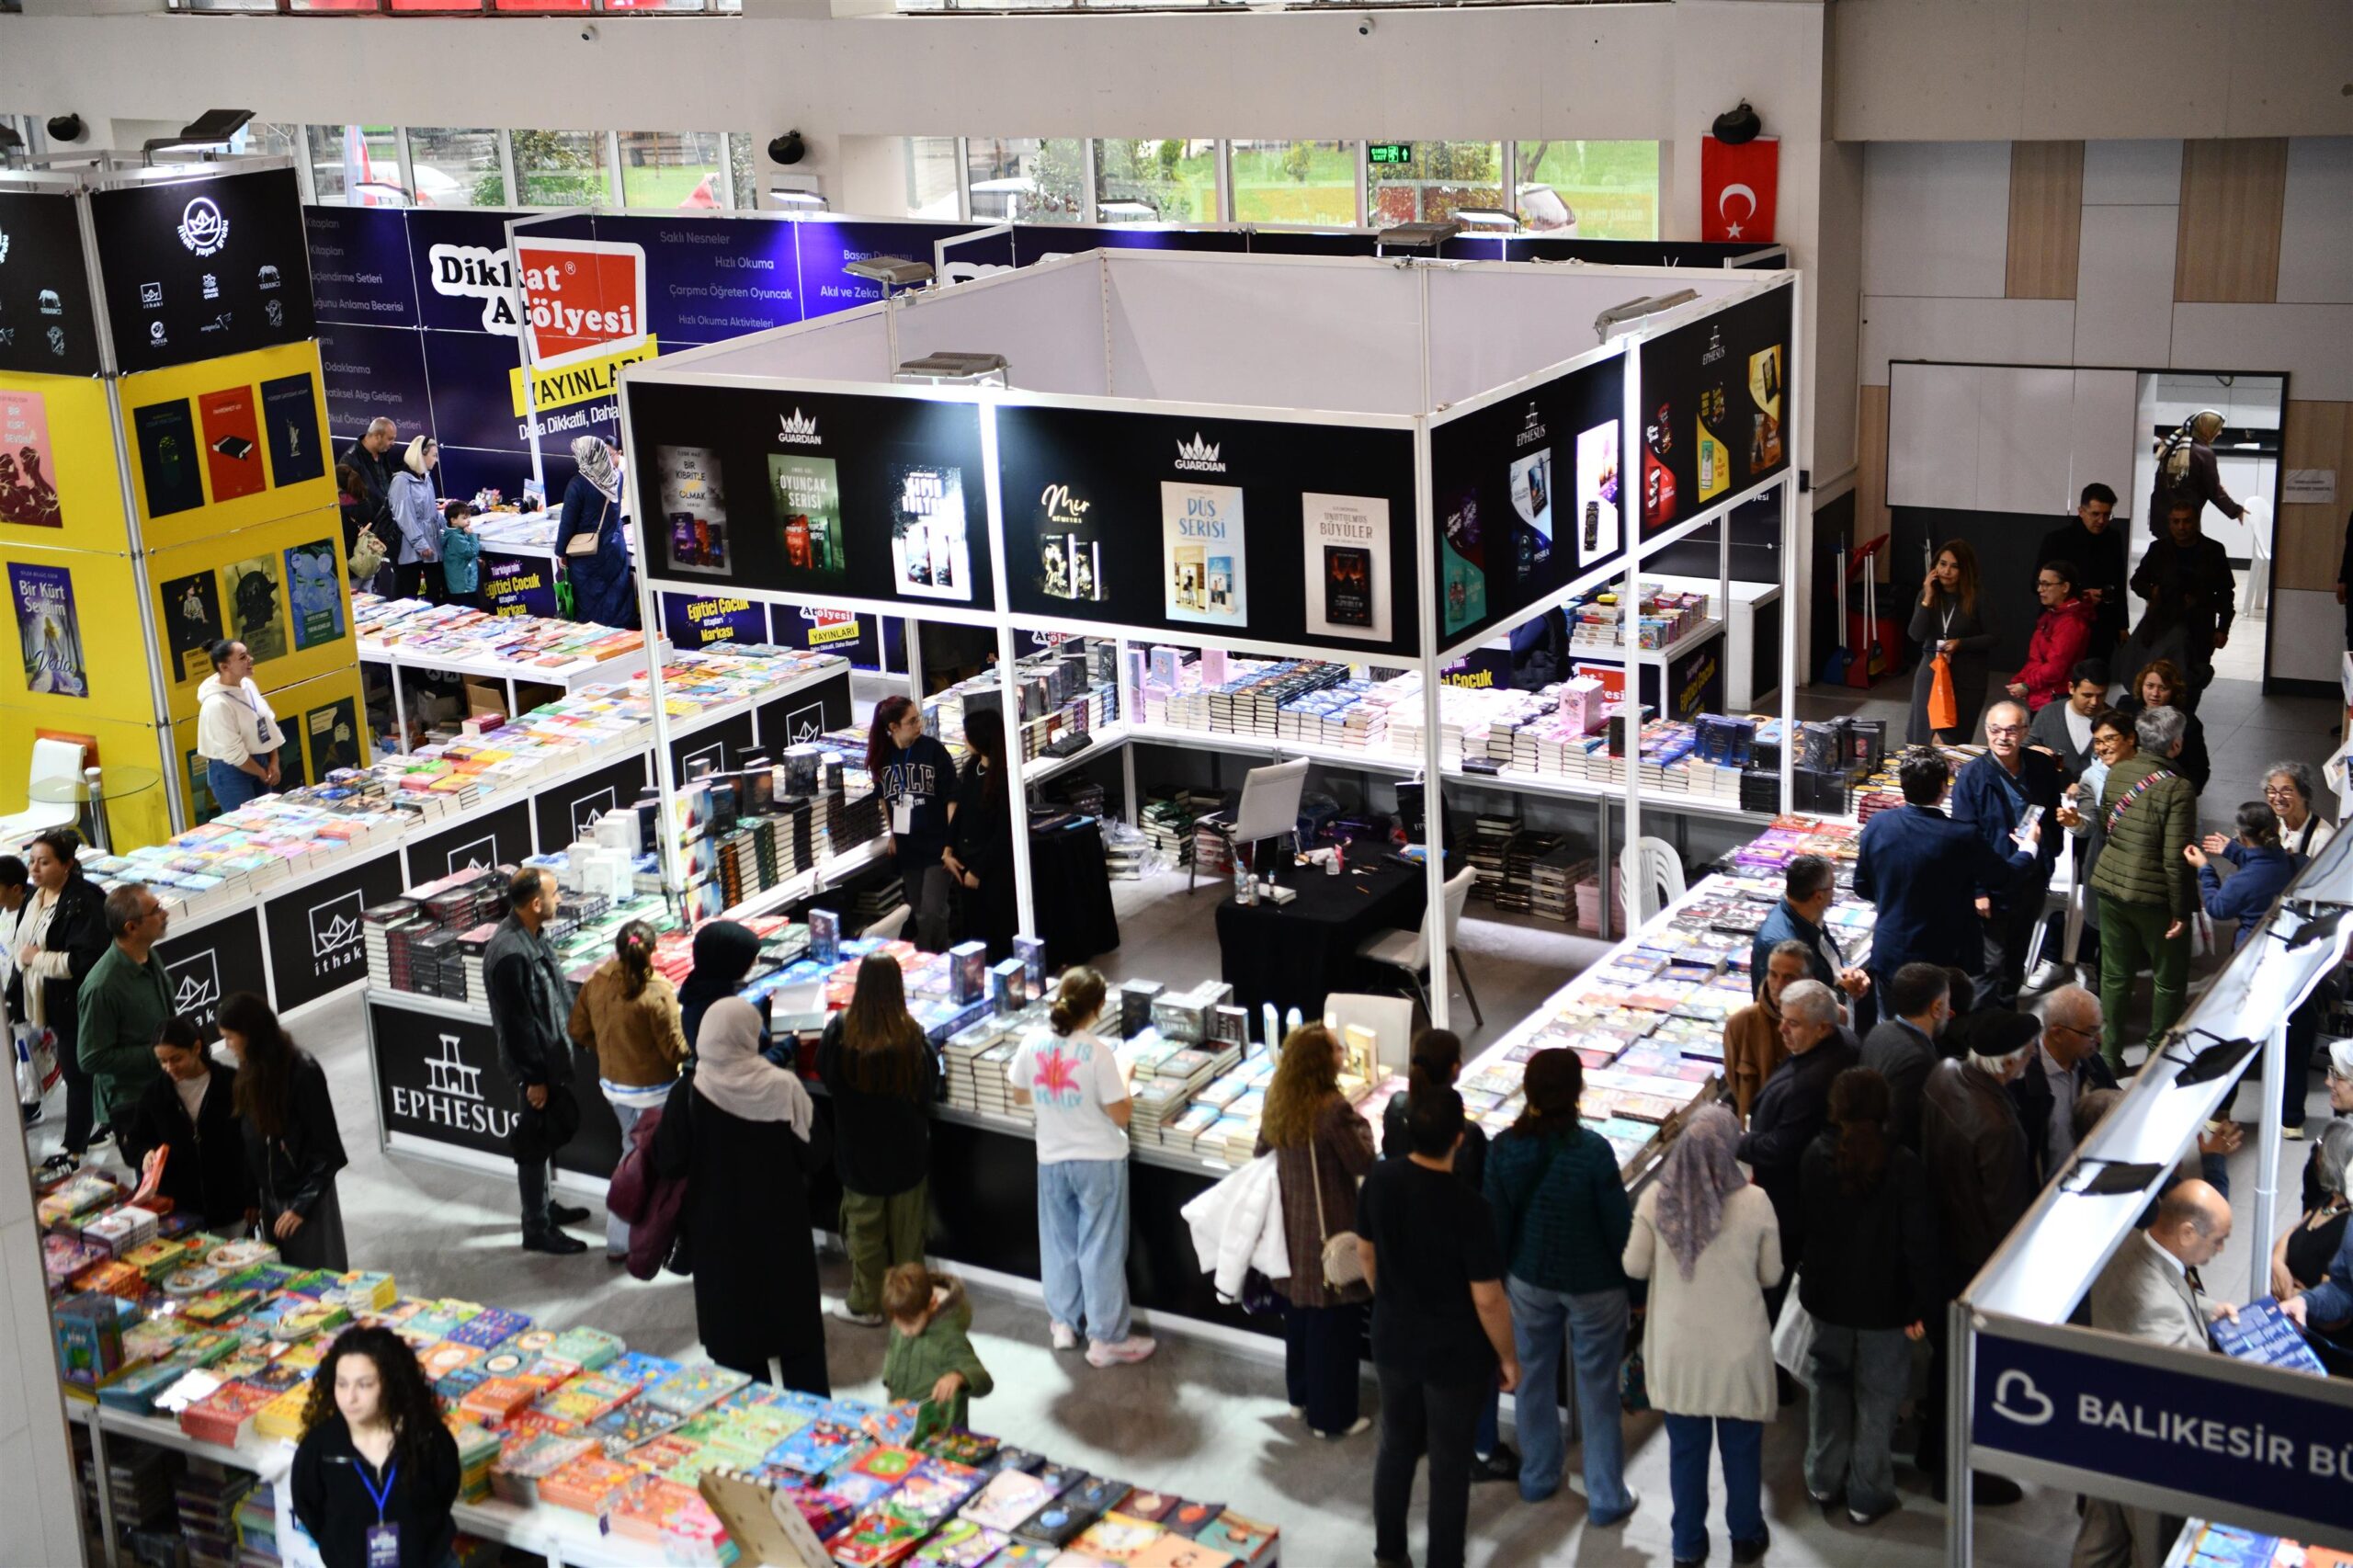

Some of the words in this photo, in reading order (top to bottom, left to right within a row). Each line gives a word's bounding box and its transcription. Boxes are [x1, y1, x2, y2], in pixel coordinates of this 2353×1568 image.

[660, 231, 685, 244] Saklı
[687, 233, 731, 244] Nesneler
[714, 256, 736, 268] Hızlı
[737, 257, 775, 270] Okuma
[356, 272, 382, 284] Setleri
[438, 256, 562, 291] Dikkat
[668, 284, 708, 299] Çarpma
[709, 283, 748, 299] Öğreten
[750, 286, 793, 301] Oyuncak
[820, 286, 839, 297] Akıl
[841, 289, 853, 298] ve
[854, 287, 880, 299] Zeka
[338, 299, 370, 310] Anlama
[371, 300, 404, 312] Becerisi
[491, 295, 634, 336] Atölyesi
[697, 315, 729, 326] Okuma
[150, 337, 168, 347] NOVA
[1702, 345, 1727, 367] EPHESUS
[324, 361, 371, 375] Odaklanma
[522, 356, 643, 406] YAYINLA
[371, 392, 403, 404] Gelişimi
[344, 414, 370, 426] Öncesi
[396, 418, 422, 430] Setleri
[518, 422, 546, 440] Daa
[547, 410, 589, 433] Dikkatli,
[590, 403, 620, 423] Daha
[778, 433, 822, 445] GUARDIAN
[1517, 424, 1546, 447] EPHESUS
[1175, 459, 1226, 472] GUARDIAN
[779, 474, 827, 492] OYUNCAK
[788, 491, 822, 509] SERİSİ
[1178, 516, 1226, 539] SERİSİ
[1319, 521, 1373, 539] BÜYÜLER
[18, 580, 37, 597] Bir
[39, 582, 65, 600] Kürt
[512, 573, 541, 596] Çocuk
[24, 597, 66, 616] Sevdim
[687, 599, 719, 623] Eğitici
[718, 597, 750, 618] Çocuk
[802, 606, 851, 621] Atölyesi
[700, 627, 734, 642] Markası
[813, 627, 855, 642] YAYINLARI
[881, 762, 936, 800] YALE
[314, 945, 363, 977] ithak
[2078, 1392, 2294, 1469] BALIKESİR
